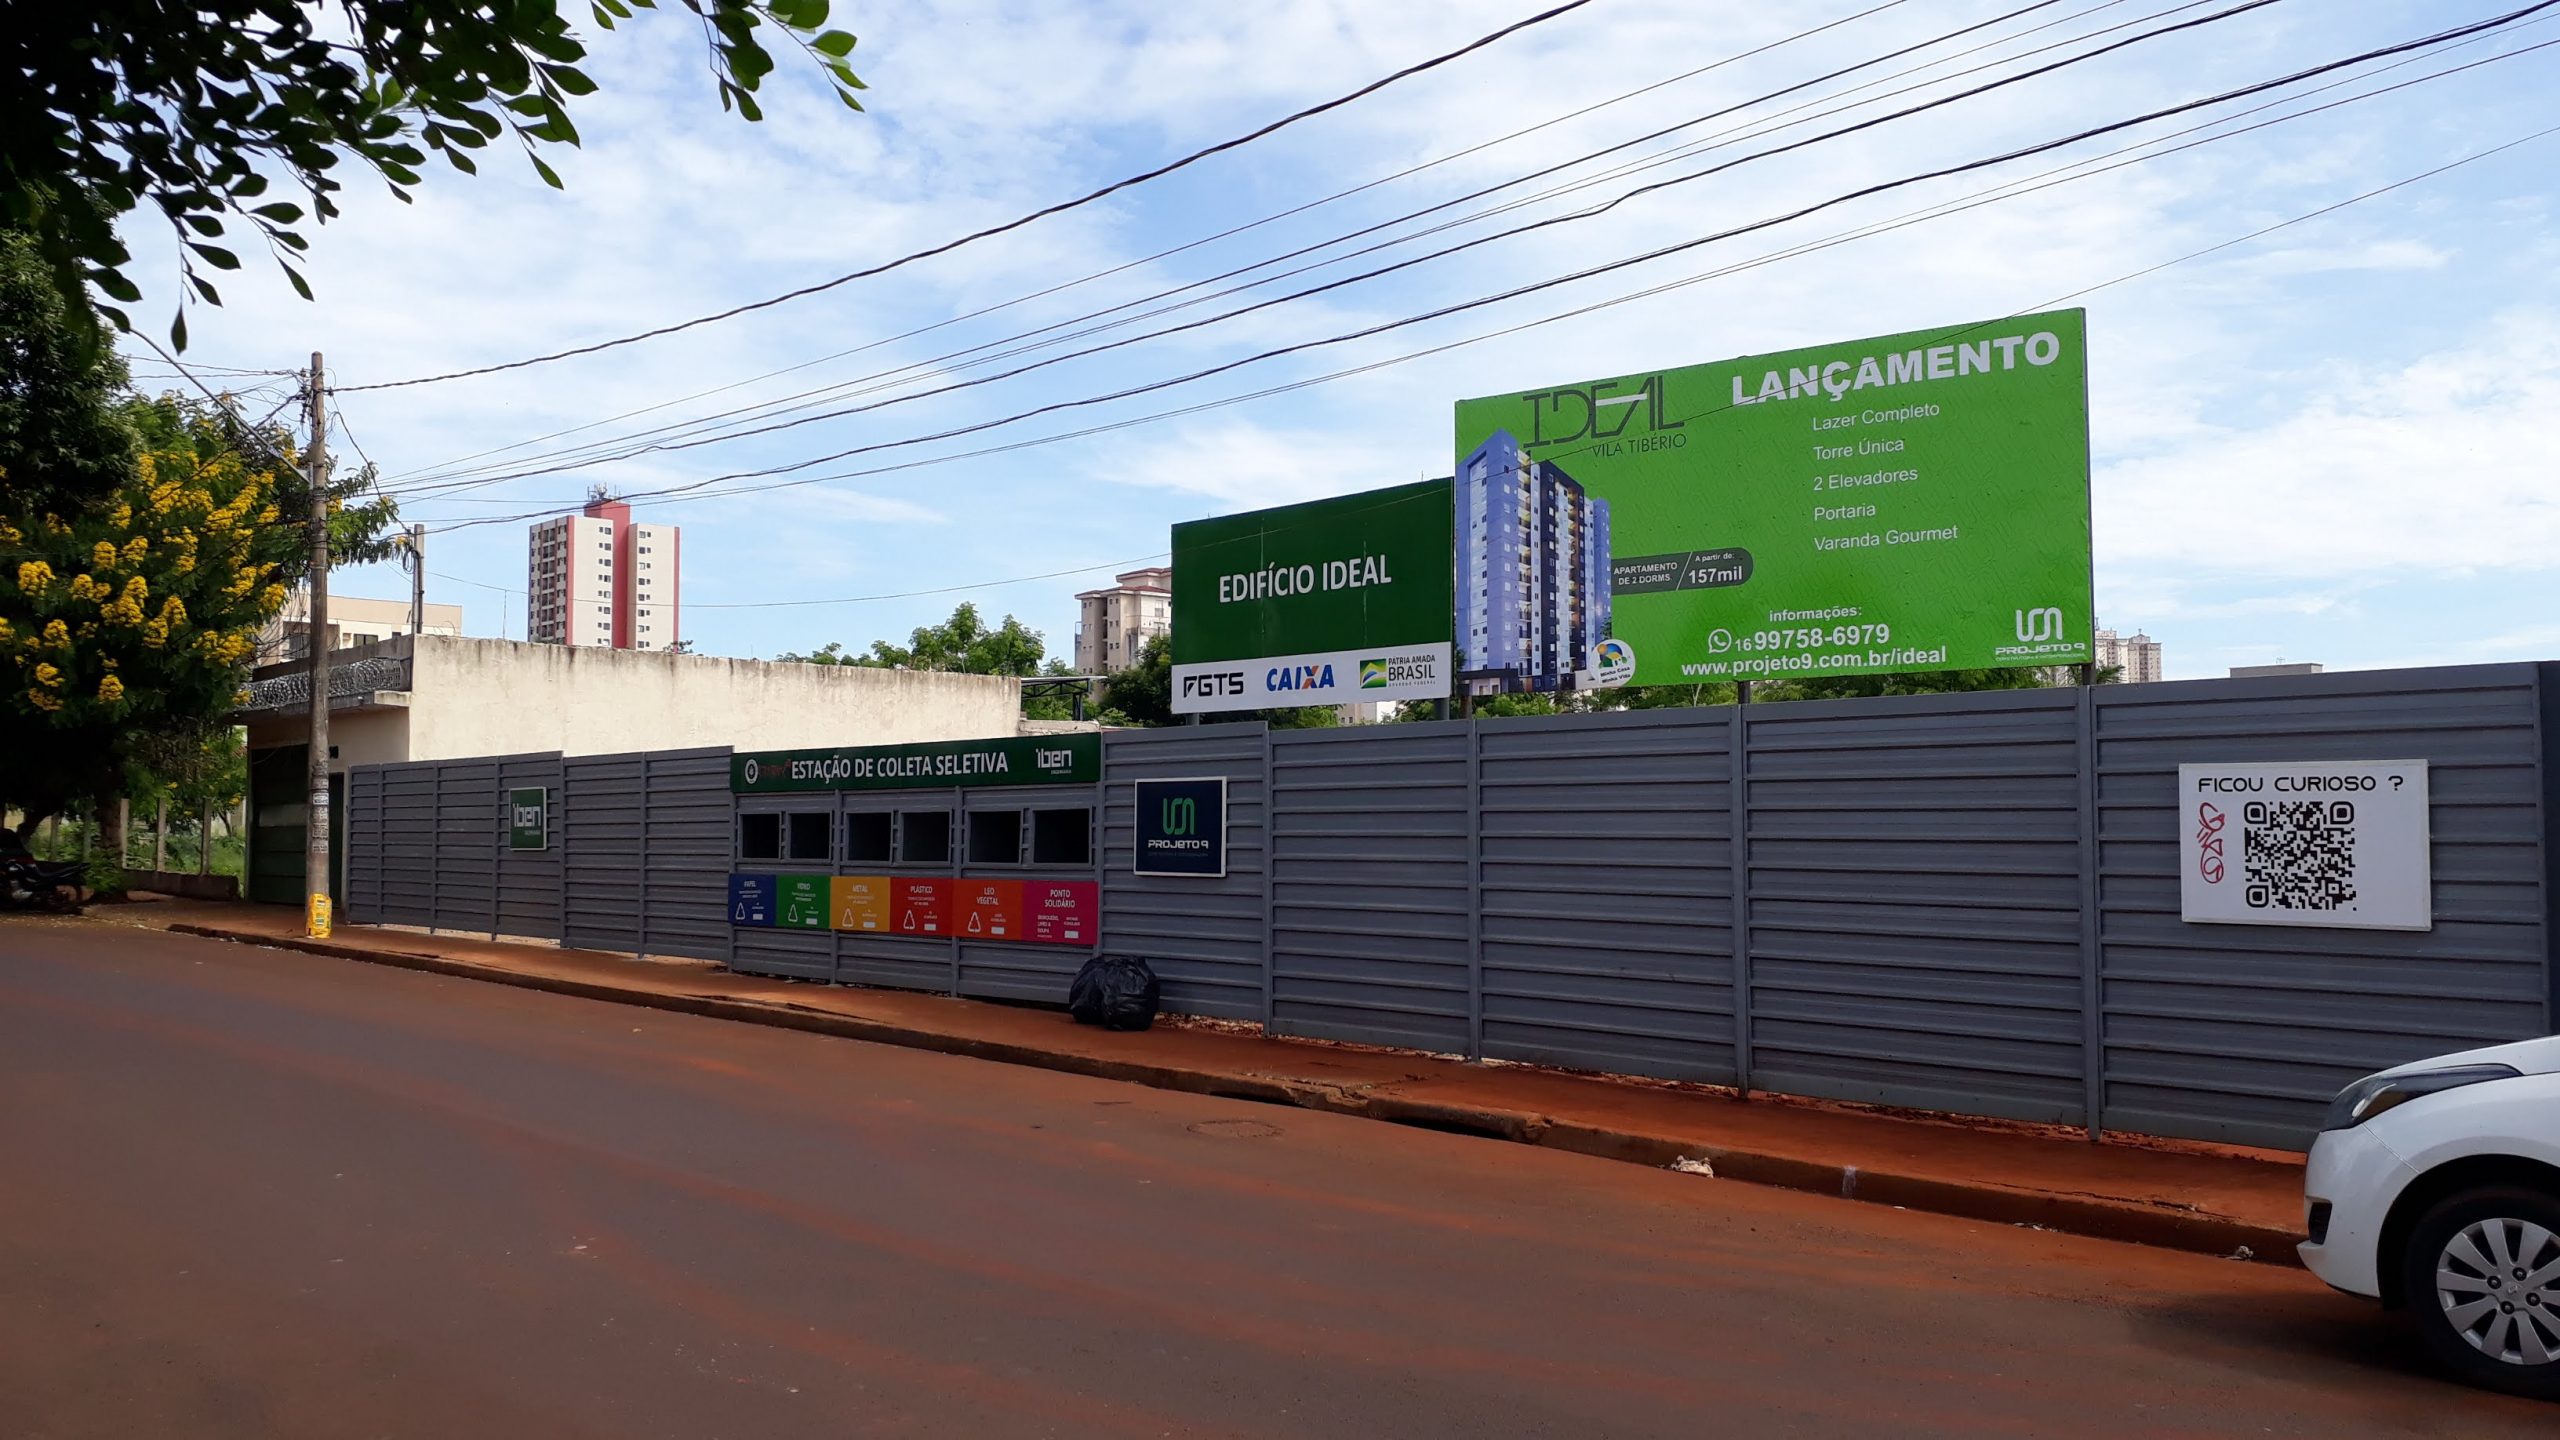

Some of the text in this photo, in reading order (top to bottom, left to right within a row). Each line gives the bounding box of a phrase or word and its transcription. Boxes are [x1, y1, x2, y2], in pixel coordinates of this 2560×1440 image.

[1732, 331, 2060, 406] LANÇAMENTO
[1523, 375, 1685, 449] IDEAL
[1813, 403, 1941, 431] Lazer Completo
[1592, 433, 1687, 457] VILA TIBÉRIO
[1813, 438, 1905, 461] Torre Única
[1813, 467, 1919, 492] 2 Elevadores
[1813, 504, 1876, 521] Portaria
[1813, 524, 1959, 551] Varanda Gourmet
[1613, 562, 1678, 575] APARTAMENTO
[1702, 554, 1721, 563] partir
[1219, 554, 1392, 603] EDIFÍCIO IDEAL
[1618, 577, 1630, 585] DE
[1632, 576, 1637, 584] 2
[1688, 565, 1743, 584] 157mil
[1769, 605, 1863, 622] informações:
[1735, 624, 1890, 652] 16 99758-6979
[1411, 654, 1436, 663] AMADA
[1681, 645, 1947, 677] www.projeto9.com.br/ideal
[1266, 664, 1335, 691] CAIXA
[1388, 664, 1436, 681] BRASIL
[1183, 672, 1244, 698] FGTS
[791, 755, 850, 784] ESTAÇÃO
[854, 758, 873, 778] DE
[877, 755, 933, 777] COLETA
[935, 751, 1009, 776] SELETIVA
[2198, 777, 2264, 792] FICOU
[2274, 775, 2377, 792] CURIOSO
[1044, 898, 1076, 908] SOLIDÁRIO
[1050, 888, 1071, 898] PONTO
